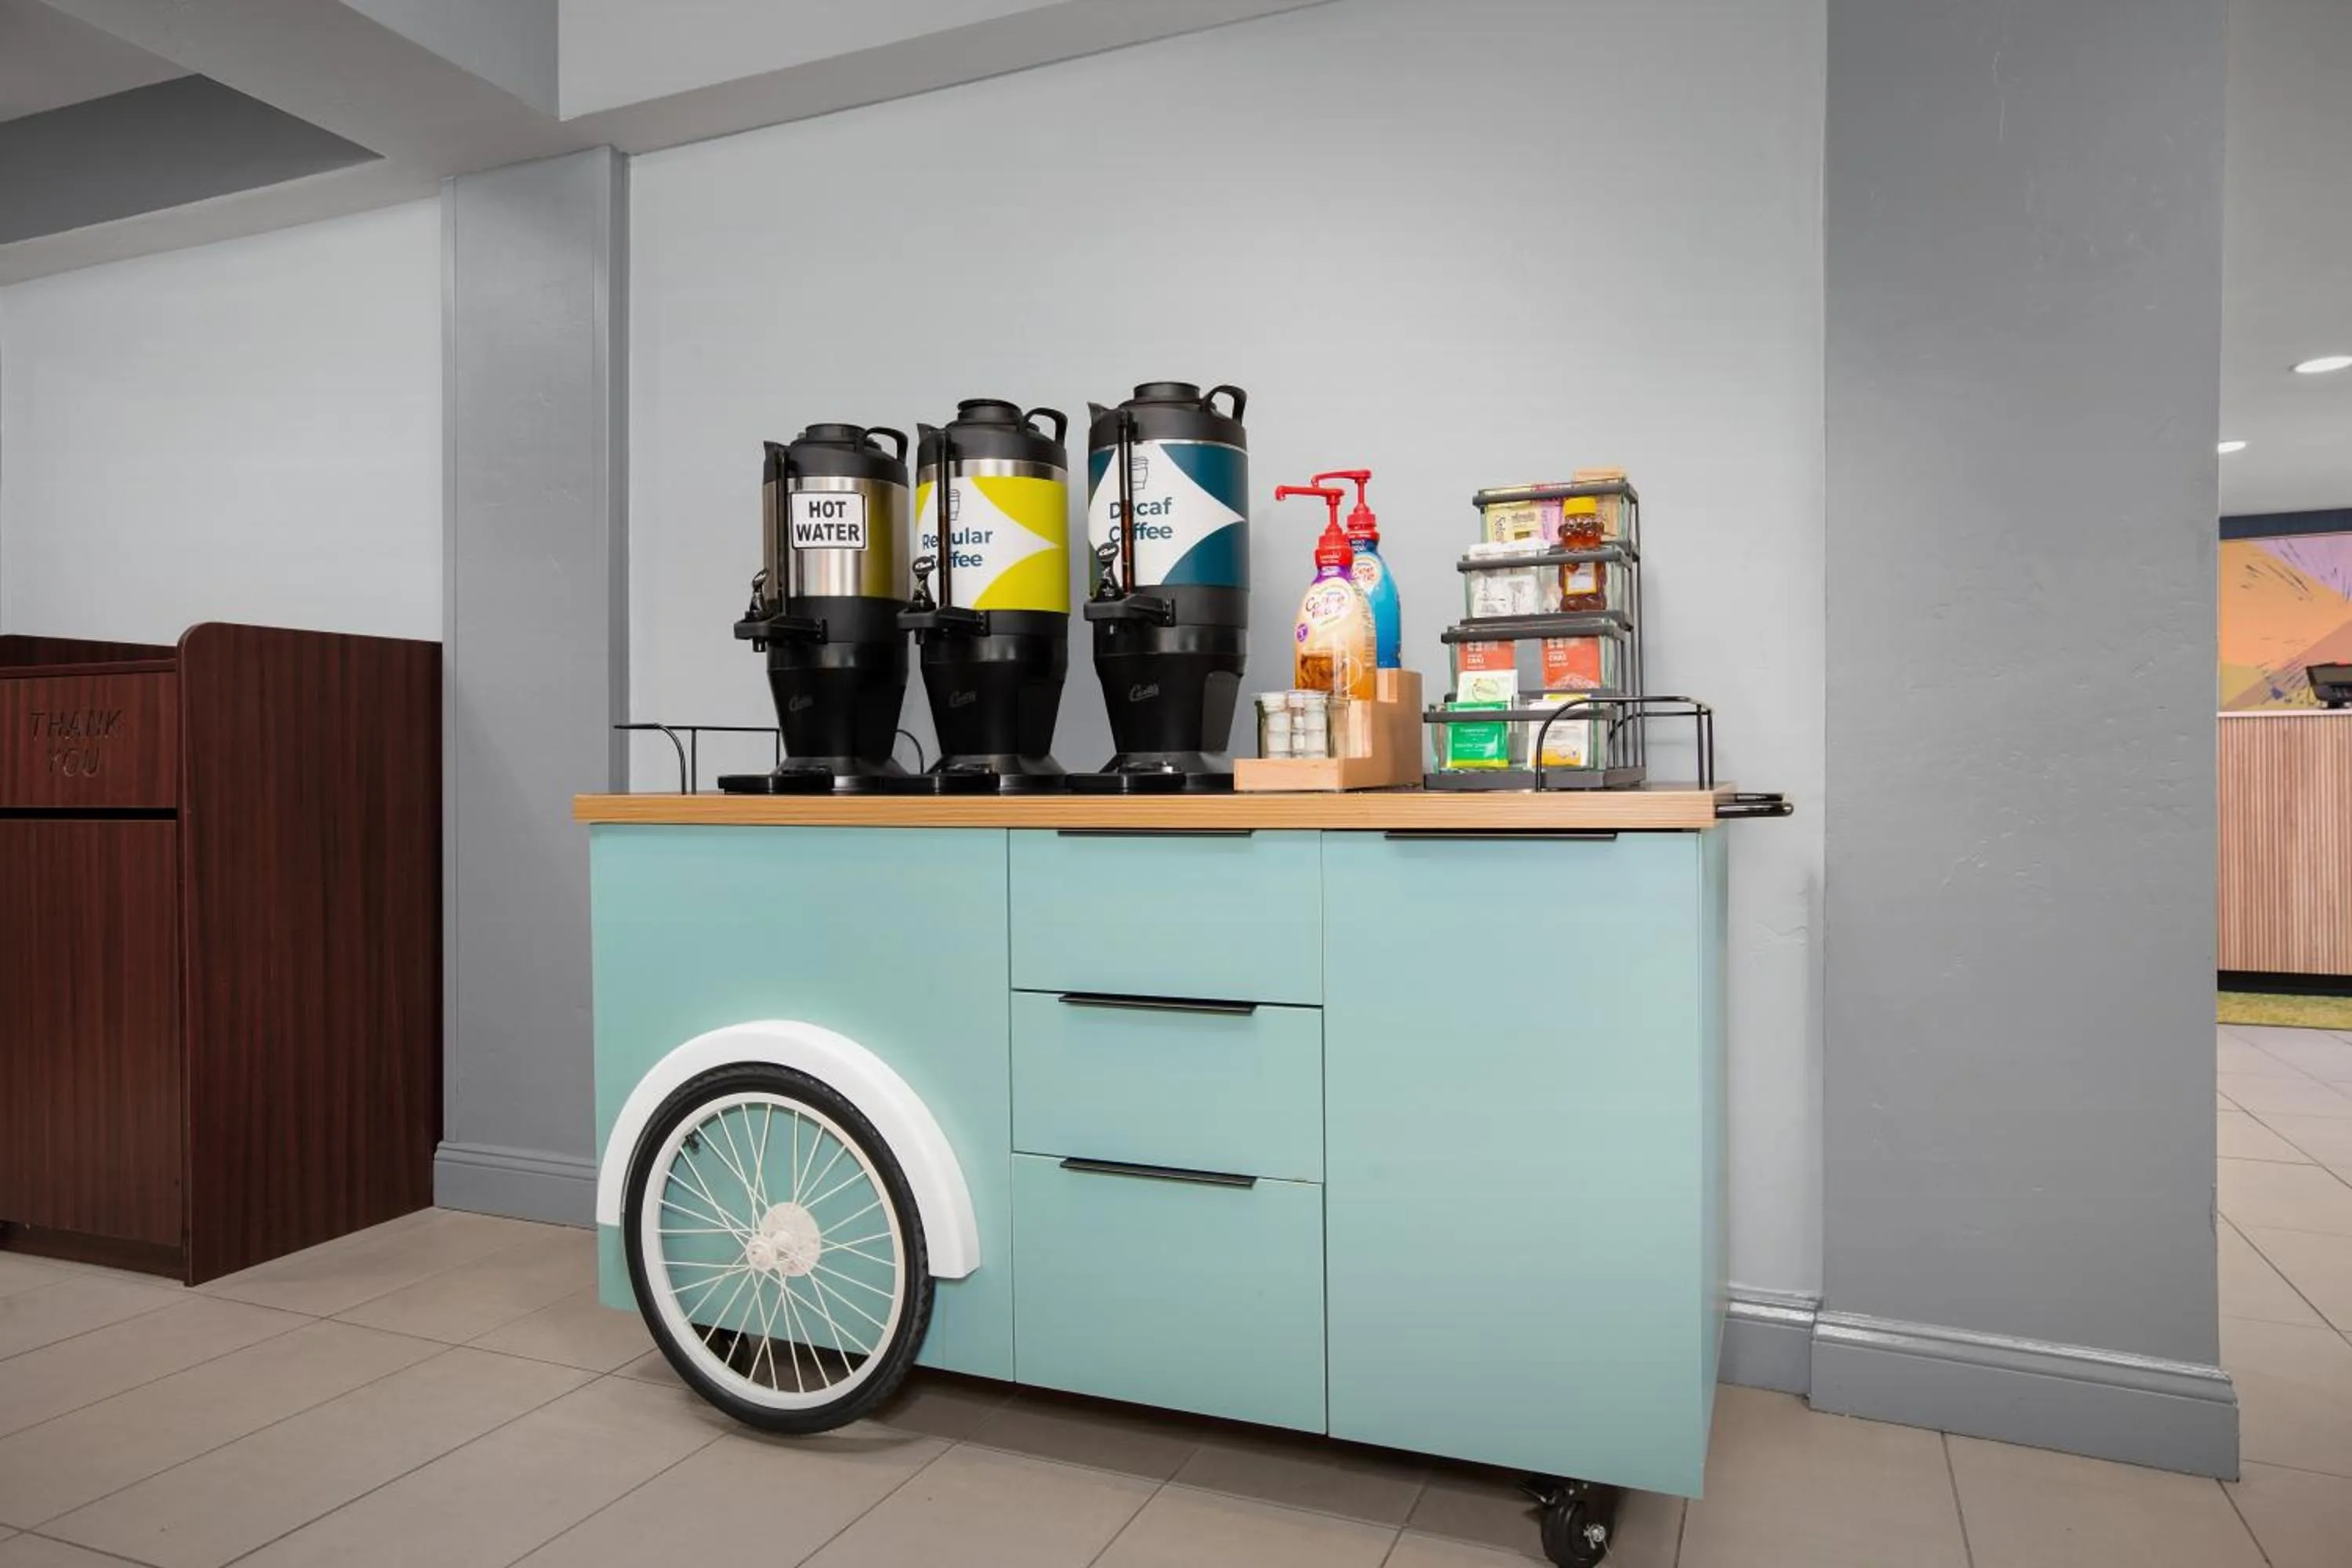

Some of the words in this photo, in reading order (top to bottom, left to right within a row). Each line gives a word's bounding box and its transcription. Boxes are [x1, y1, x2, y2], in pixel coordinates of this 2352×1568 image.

[808, 500, 847, 518] HOT
[1109, 496, 1173, 519] Dcaf
[796, 523, 860, 542] WATER
[923, 527, 993, 550] Reular
[1109, 521, 1173, 543] Cffee
[928, 550, 983, 568] fee
[31, 709, 123, 738] THANK
[48, 747, 100, 777] YOU
